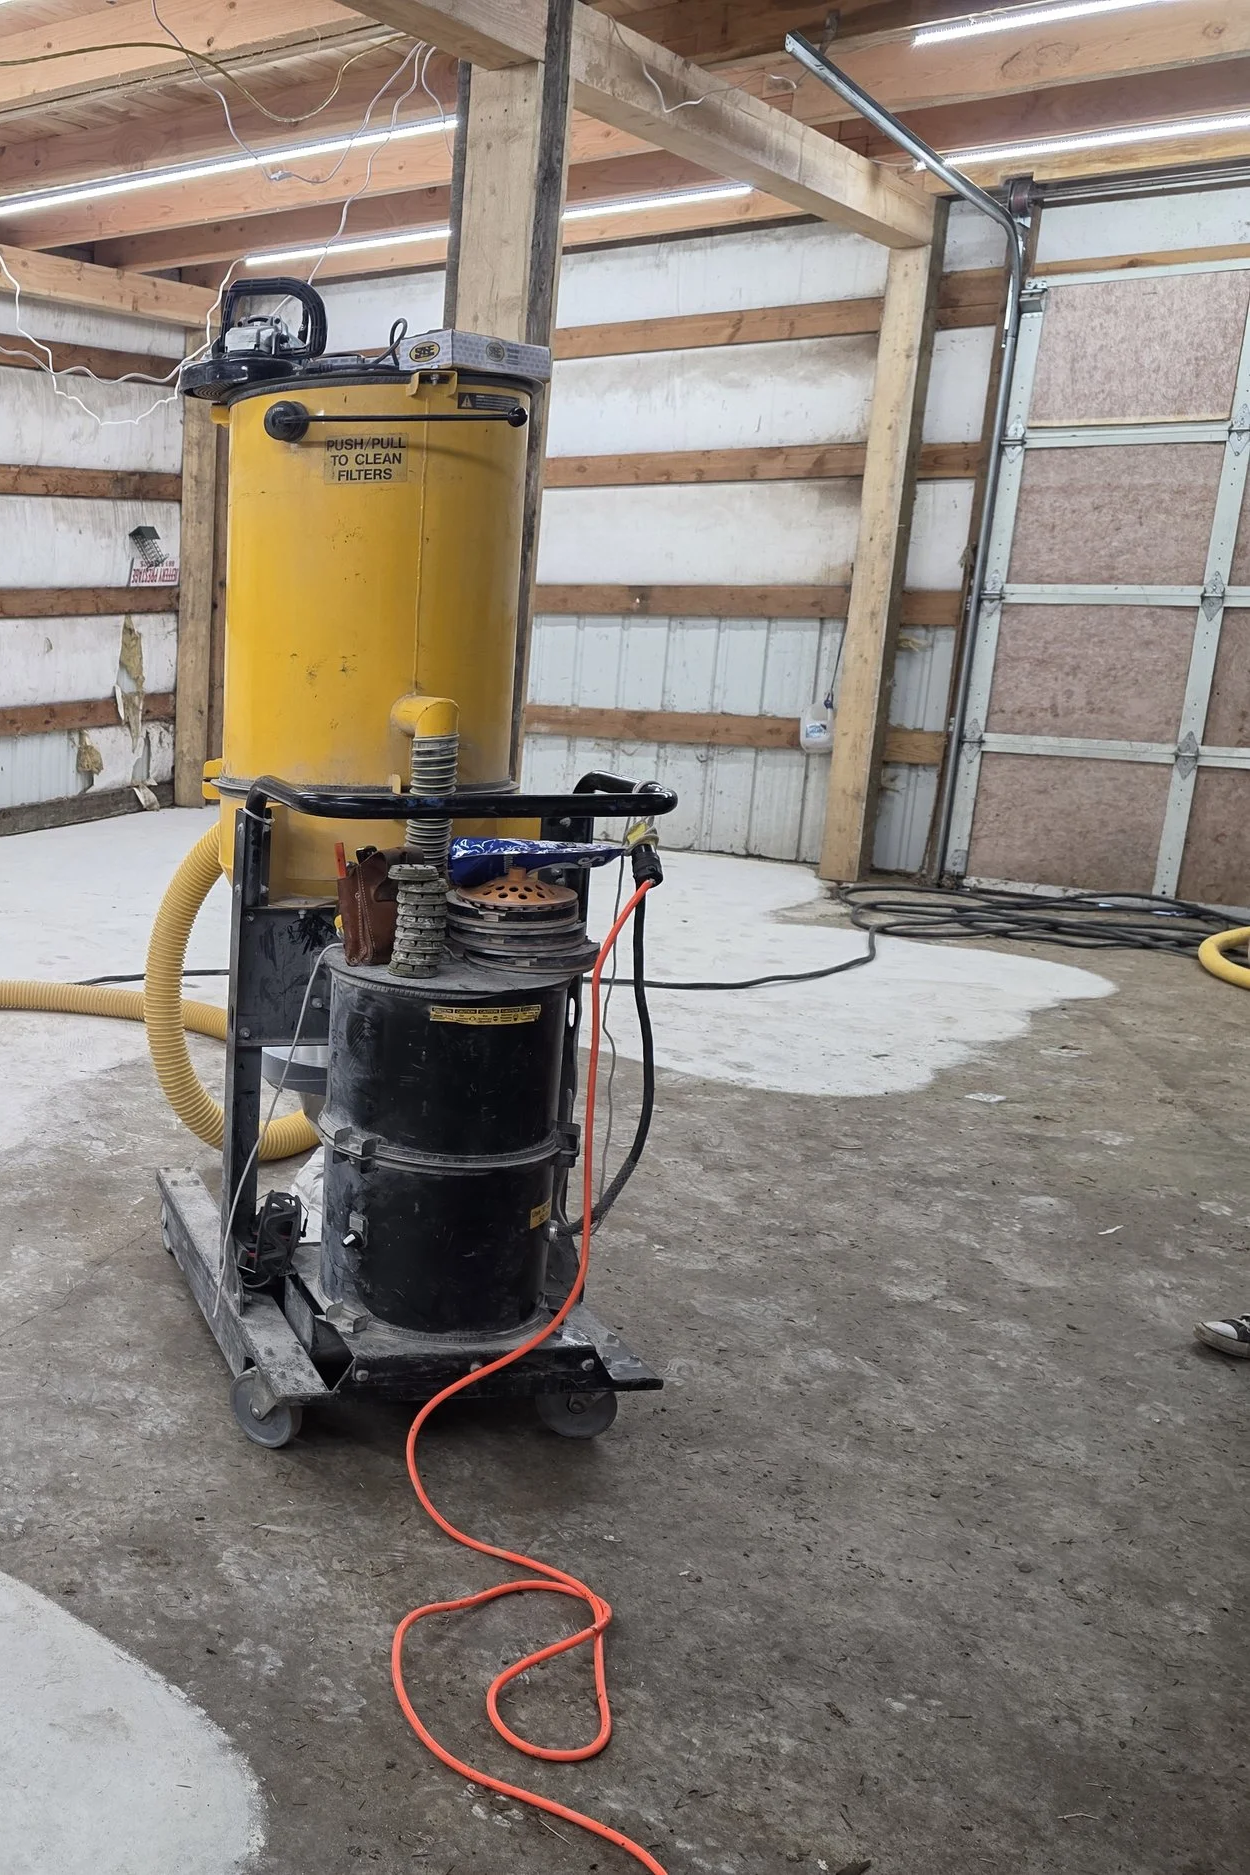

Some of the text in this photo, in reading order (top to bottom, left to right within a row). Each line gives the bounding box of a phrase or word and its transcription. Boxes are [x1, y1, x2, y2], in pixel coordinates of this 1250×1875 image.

[326, 437, 407, 451] PUSH/PULL
[330, 453, 402, 467] TO CLEAN
[337, 468, 393, 482] FILTERS
